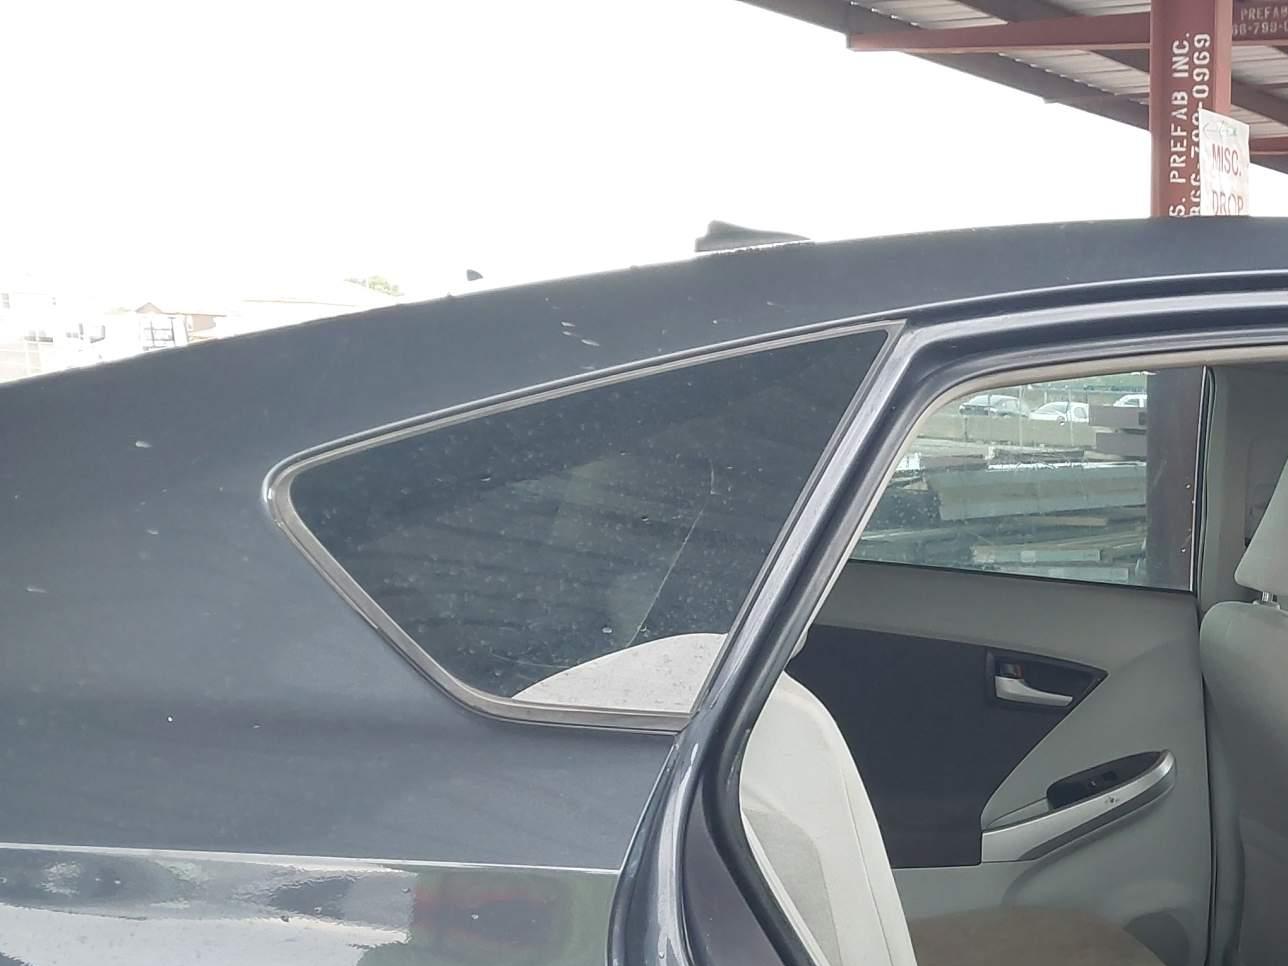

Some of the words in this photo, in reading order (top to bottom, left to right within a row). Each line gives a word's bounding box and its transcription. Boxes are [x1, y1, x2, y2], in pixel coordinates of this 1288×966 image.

[1240, 6, 1288, 20] PREFAB
[1172, 32, 1190, 78] INC.
[1169, 91, 1188, 184] PREFAB
[1212, 143, 1243, 177] MISC.
[1212, 189, 1245, 216] DROP
